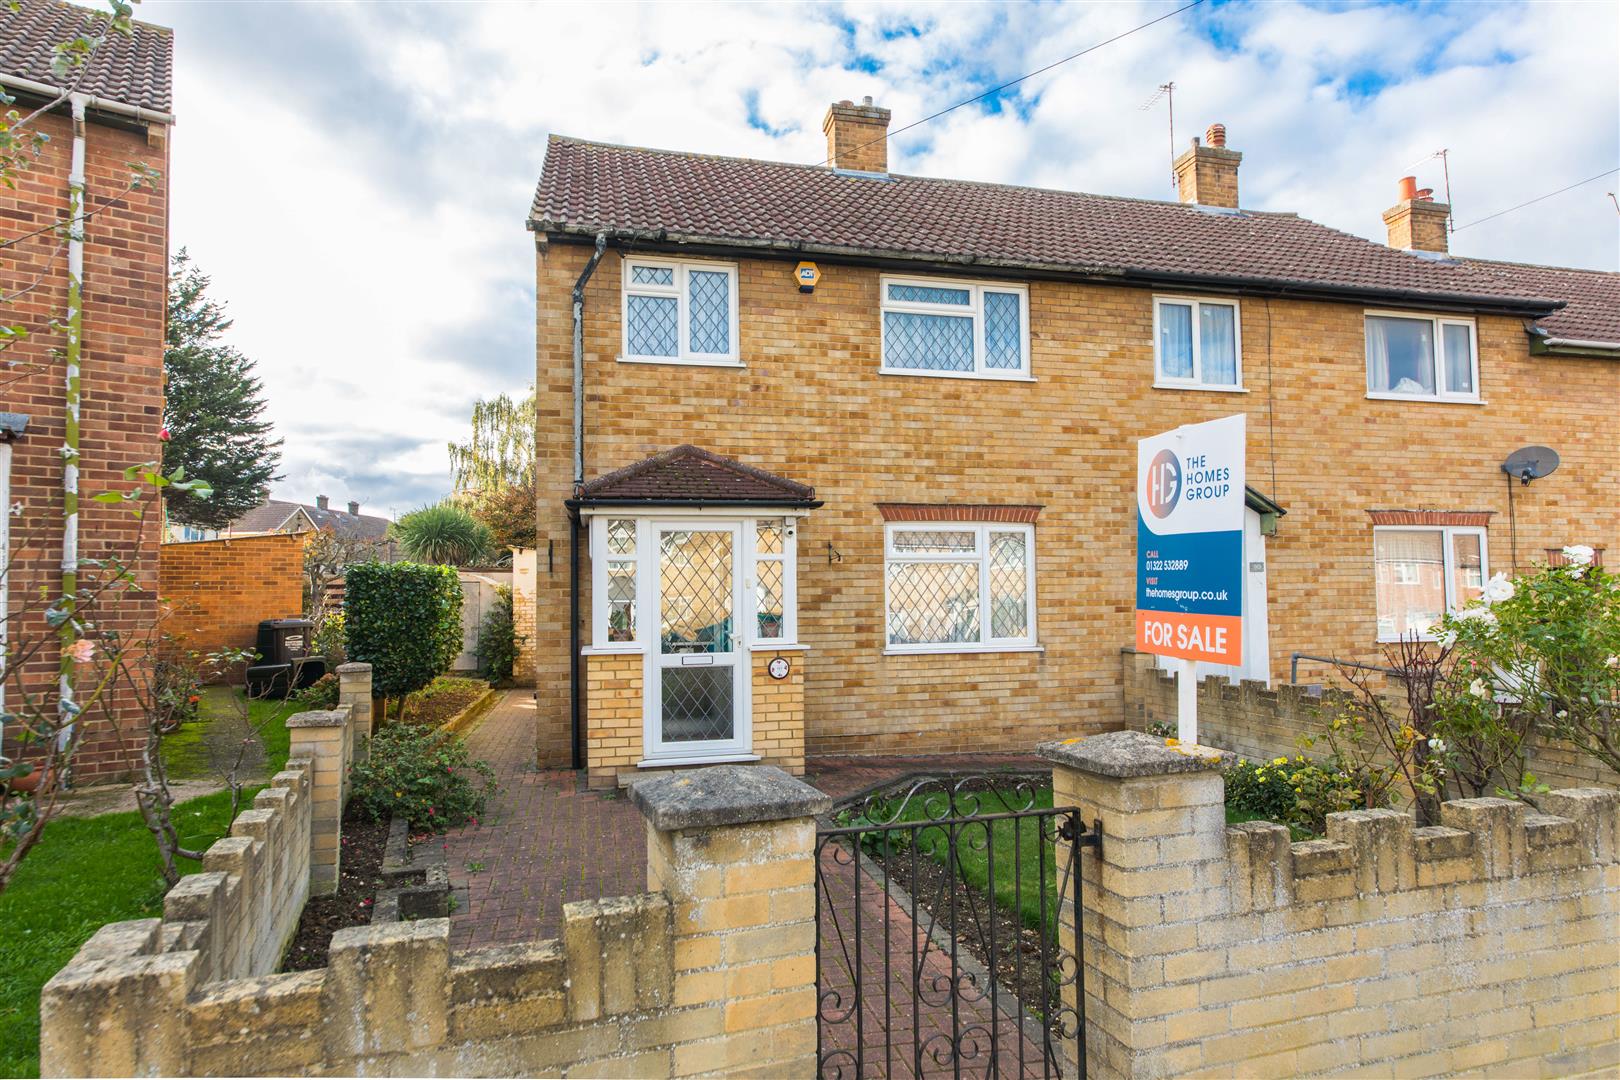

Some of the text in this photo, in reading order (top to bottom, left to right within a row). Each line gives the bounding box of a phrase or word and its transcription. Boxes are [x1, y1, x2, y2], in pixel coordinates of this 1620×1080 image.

[1186, 455, 1206, 470] THE
[1186, 467, 1230, 485] HOMES
[1186, 484, 1230, 501] GROUP
[1146, 550, 1159, 559] CALL
[1146, 560, 1189, 571] 01322 532889
[1146, 577, 1158, 585] VISIT
[1146, 588, 1228, 602] thehomesgroup.co.uk
[1144, 621, 1227, 654] FOR SALE
